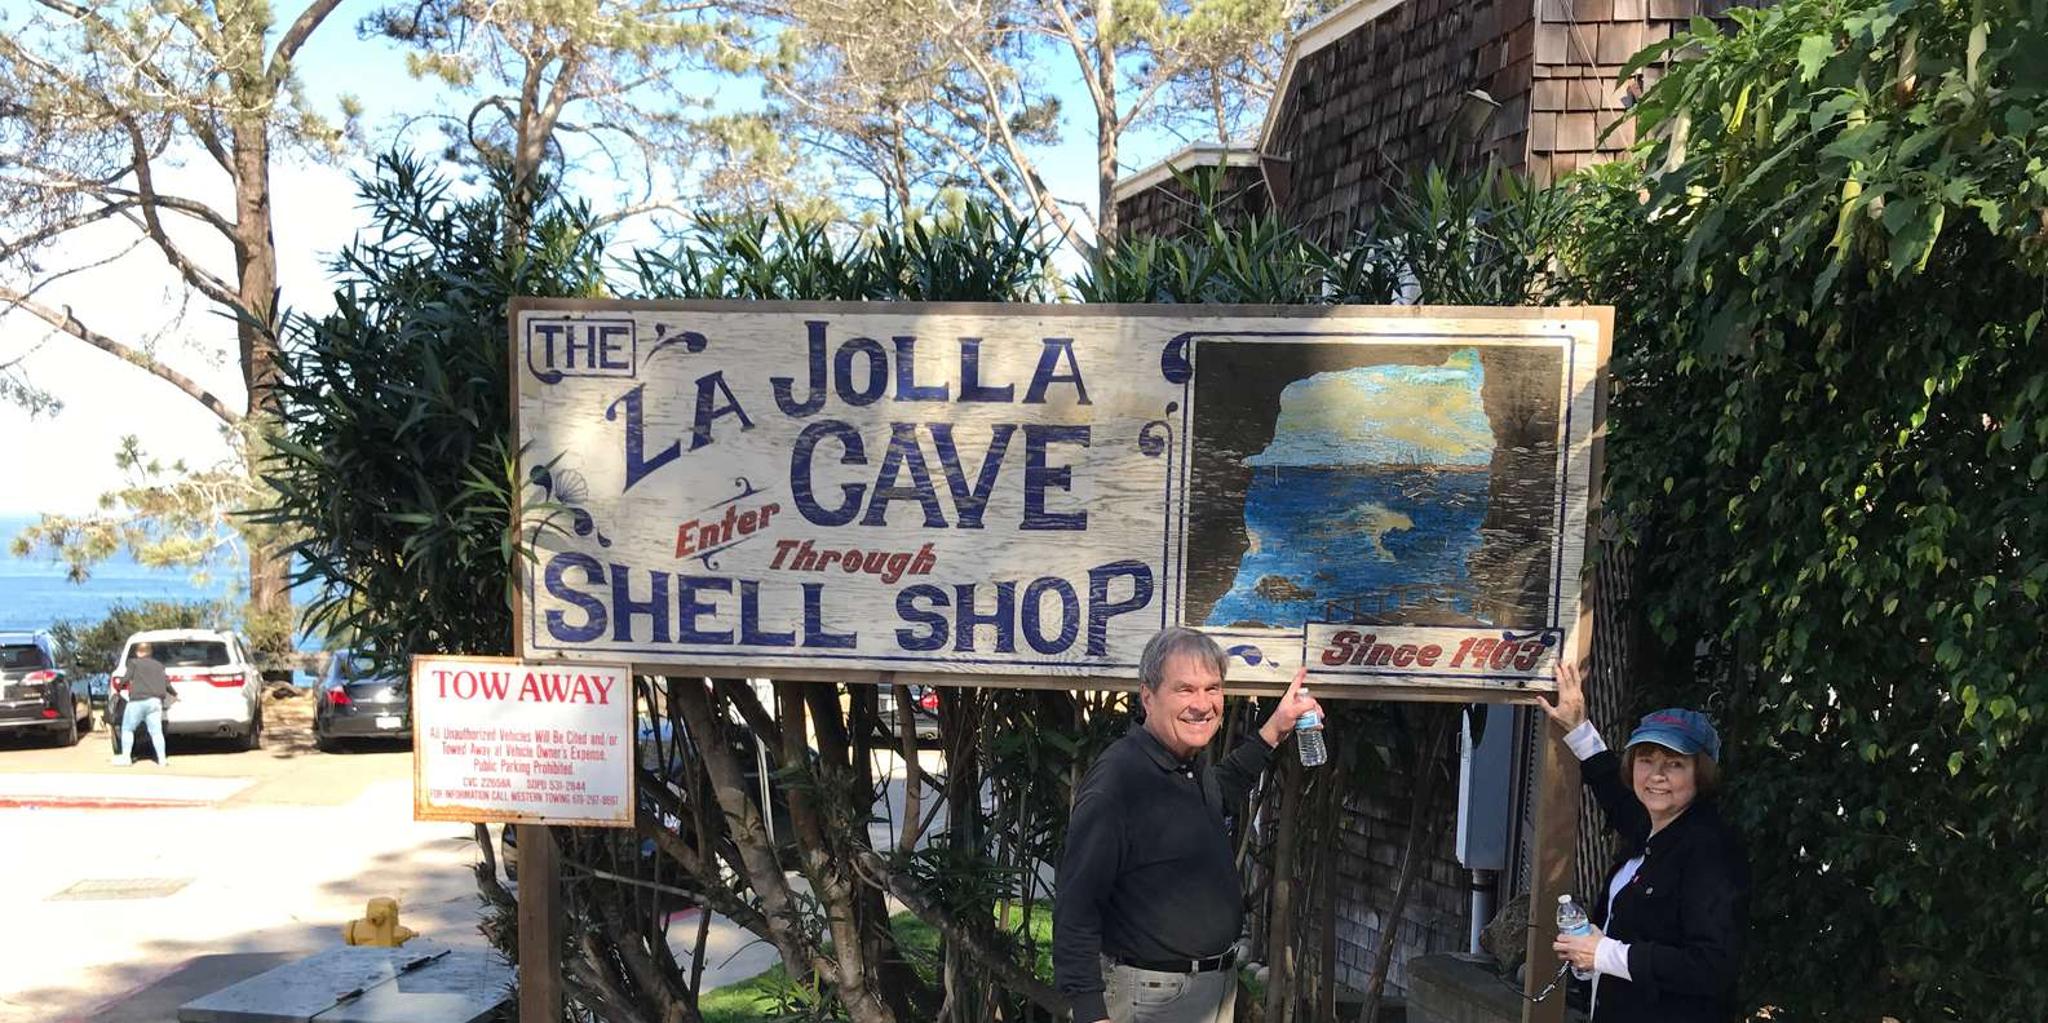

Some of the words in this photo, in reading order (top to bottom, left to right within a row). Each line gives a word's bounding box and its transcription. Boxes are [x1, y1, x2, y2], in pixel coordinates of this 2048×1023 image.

[535, 325, 629, 369] THE
[605, 370, 756, 493] LA
[769, 320, 1093, 418] JOLLA
[790, 419, 1092, 531] CAVE
[675, 502, 781, 559] Enter
[769, 540, 938, 584] Through
[543, 551, 858, 650] SHELL
[895, 559, 1155, 657] SHOP
[1321, 630, 1444, 667] Since
[1449, 637, 1546, 671] 1903
[432, 670, 511, 700] TOW
[518, 673, 616, 705] AWAY
[442, 741, 466, 755] Towed
[471, 742, 490, 758] Away
[506, 744, 533, 757] Vehicle
[443, 727, 496, 740] Unauthorized
[500, 728, 531, 742] Vehicles
[535, 729, 550, 743] Will
[553, 730, 563, 744] Be
[566, 730, 587, 744] Cited
[463, 777, 478, 787] CVC
[474, 758, 497, 772] Public
[501, 759, 530, 776] Parking
[445, 789, 489, 800] INFORMATION
[492, 790, 508, 801] CALL
[511, 791, 543, 802] WESTERN
[545, 792, 570, 803] TOWING
